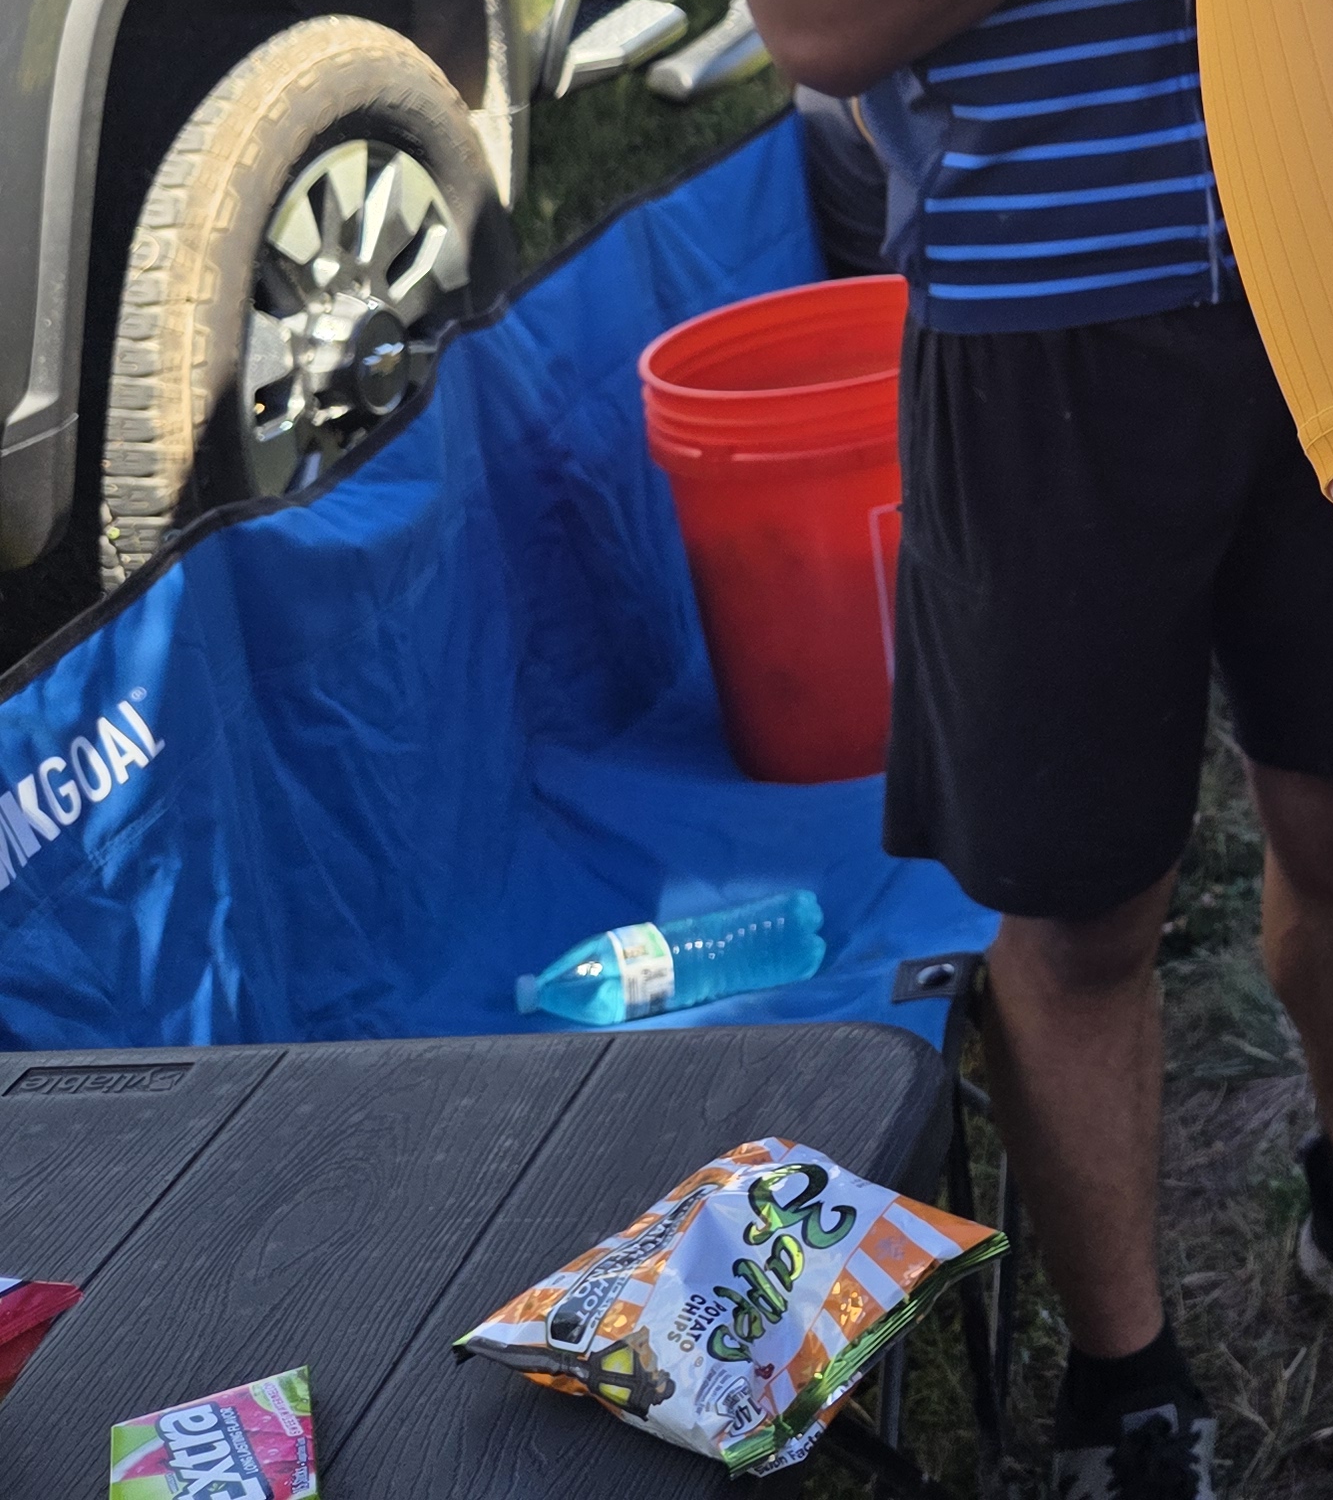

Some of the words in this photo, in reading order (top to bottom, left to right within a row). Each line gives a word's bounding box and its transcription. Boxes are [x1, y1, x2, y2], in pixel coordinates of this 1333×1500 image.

[575, 1278, 611, 1326] HOT
[666, 1294, 707, 1344] CHIPS
[679, 1300, 728, 1353] POTATO
